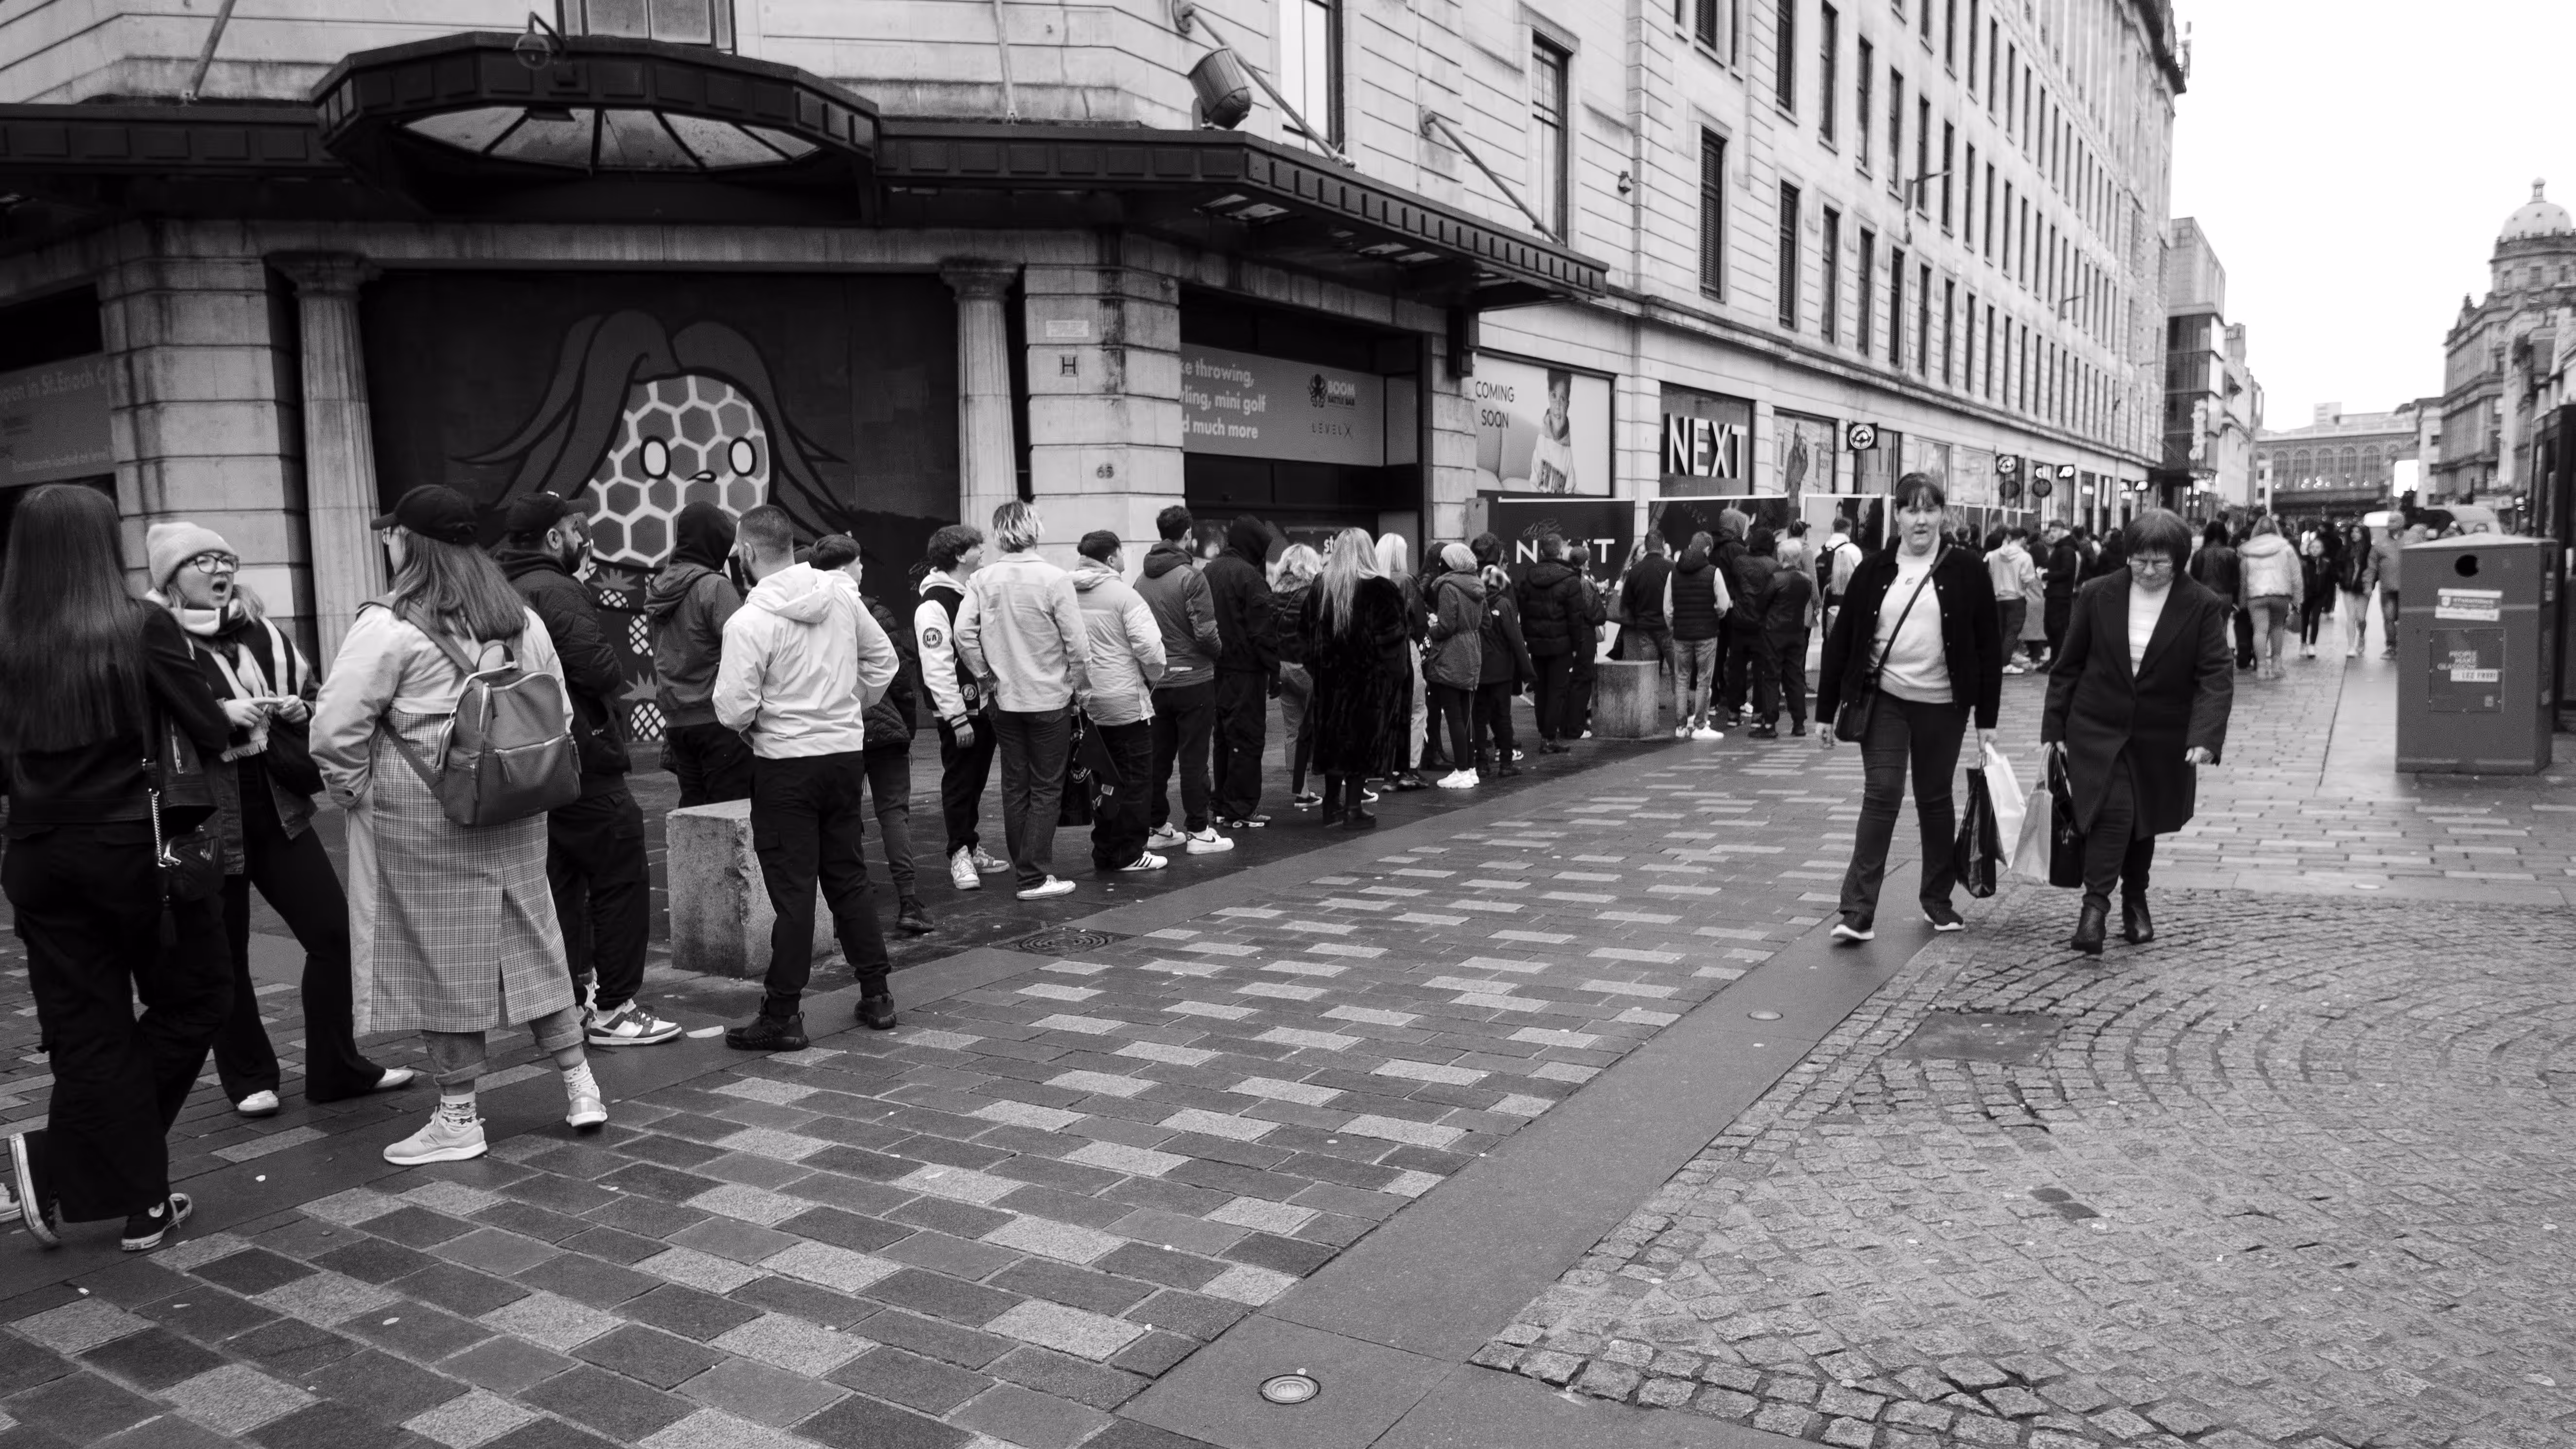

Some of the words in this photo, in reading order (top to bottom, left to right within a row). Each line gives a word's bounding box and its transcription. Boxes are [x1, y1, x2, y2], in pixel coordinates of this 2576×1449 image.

[1062, 357, 1076, 375] H
[1195, 358, 1254, 388] throwing,
[1180, 384, 1212, 411] ling,
[1215, 390, 1240, 410] mini
[1243, 394, 1266, 415] golf
[1327, 380, 1355, 397] BOOM
[1475, 381, 1514, 402] COMING
[1193, 416, 1225, 436] much
[1228, 424, 1258, 439] more
[1481, 409, 1509, 429] SOON
[1669, 413, 1748, 480] NEXT
[1516, 538, 1616, 564] NT
